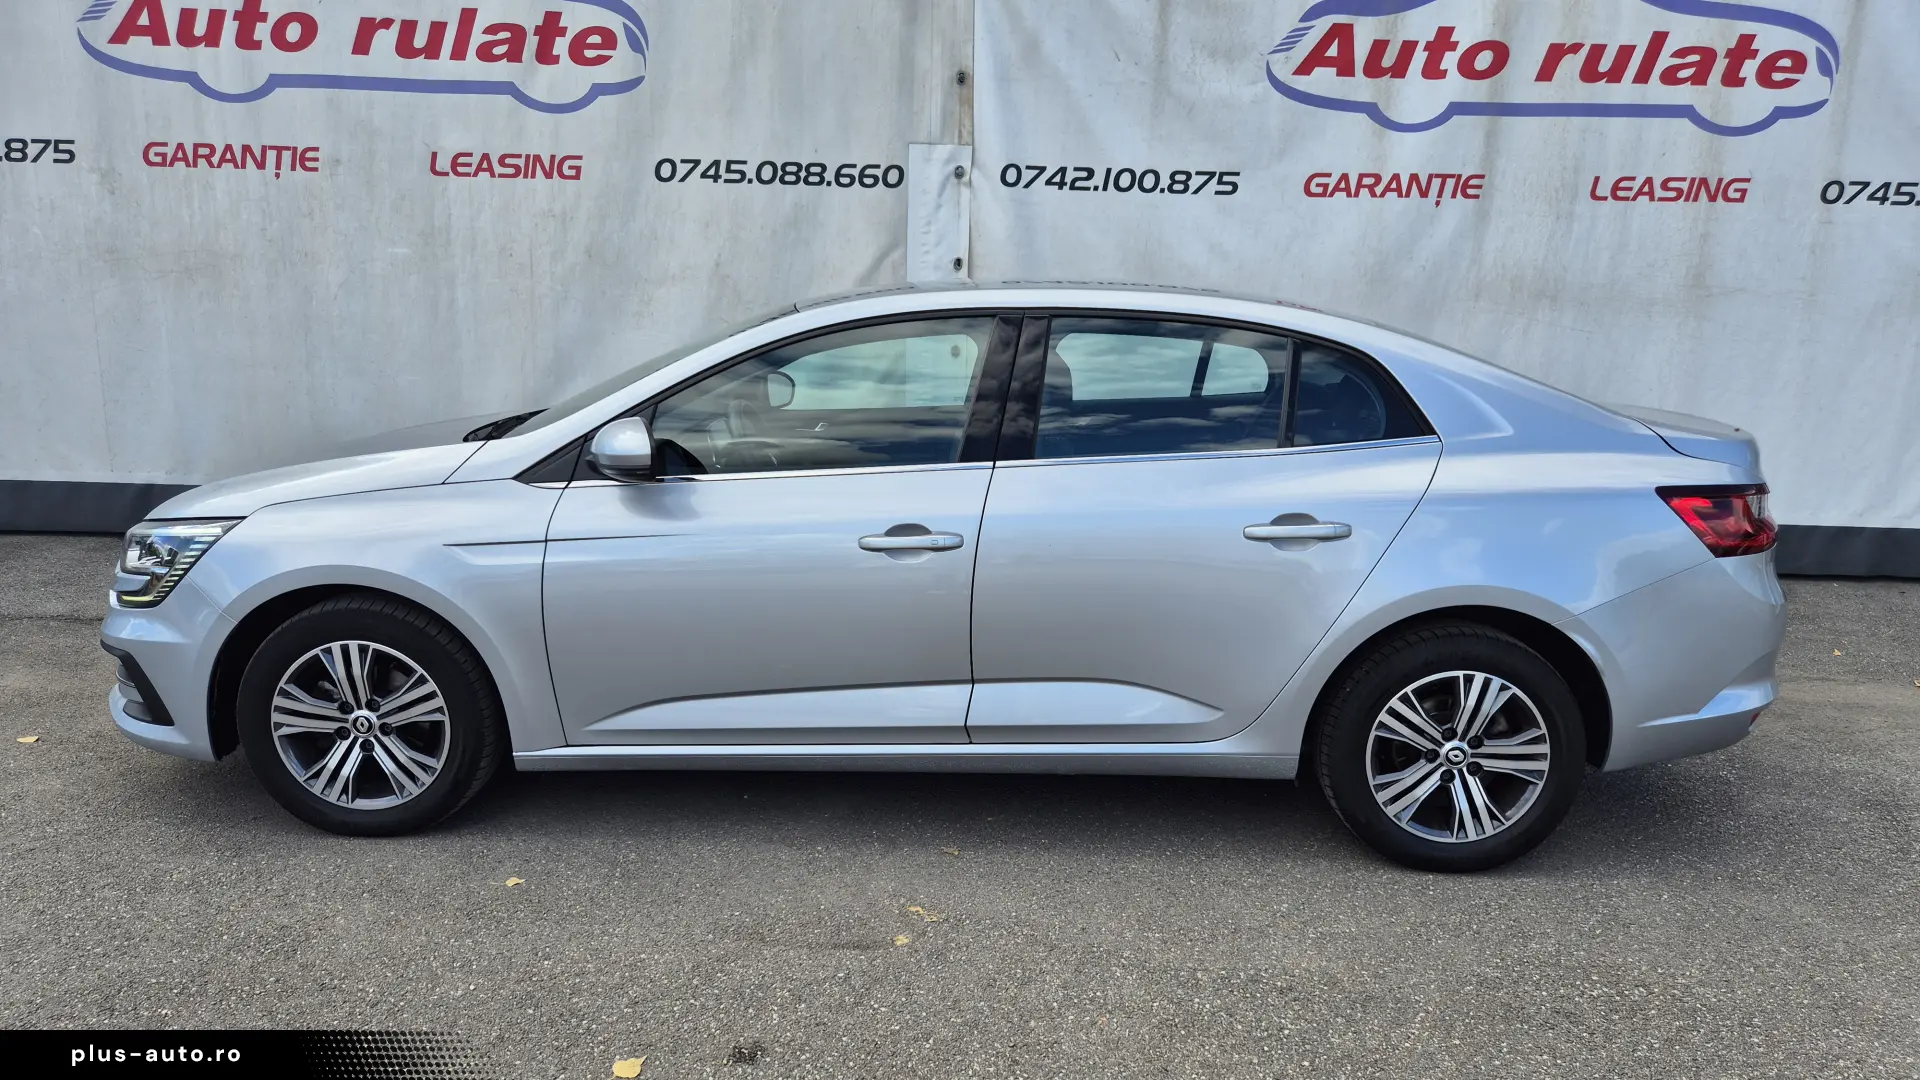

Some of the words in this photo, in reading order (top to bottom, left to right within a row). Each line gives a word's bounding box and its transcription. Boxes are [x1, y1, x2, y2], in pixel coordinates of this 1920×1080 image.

[107, 0, 319, 53] Auto
[350, 6, 619, 68] rulate
[1291, 22, 1511, 82] Auto
[1534, 30, 1810, 91] rulate
[142, 141, 320, 180] GARANȚIE
[429, 151, 584, 181] LEASING
[653, 157, 905, 189] 0745.088.660
[999, 162, 1242, 196] 0742.100.875
[1303, 172, 1486, 209] GARANȚIE
[1589, 175, 1752, 204] LEASING
